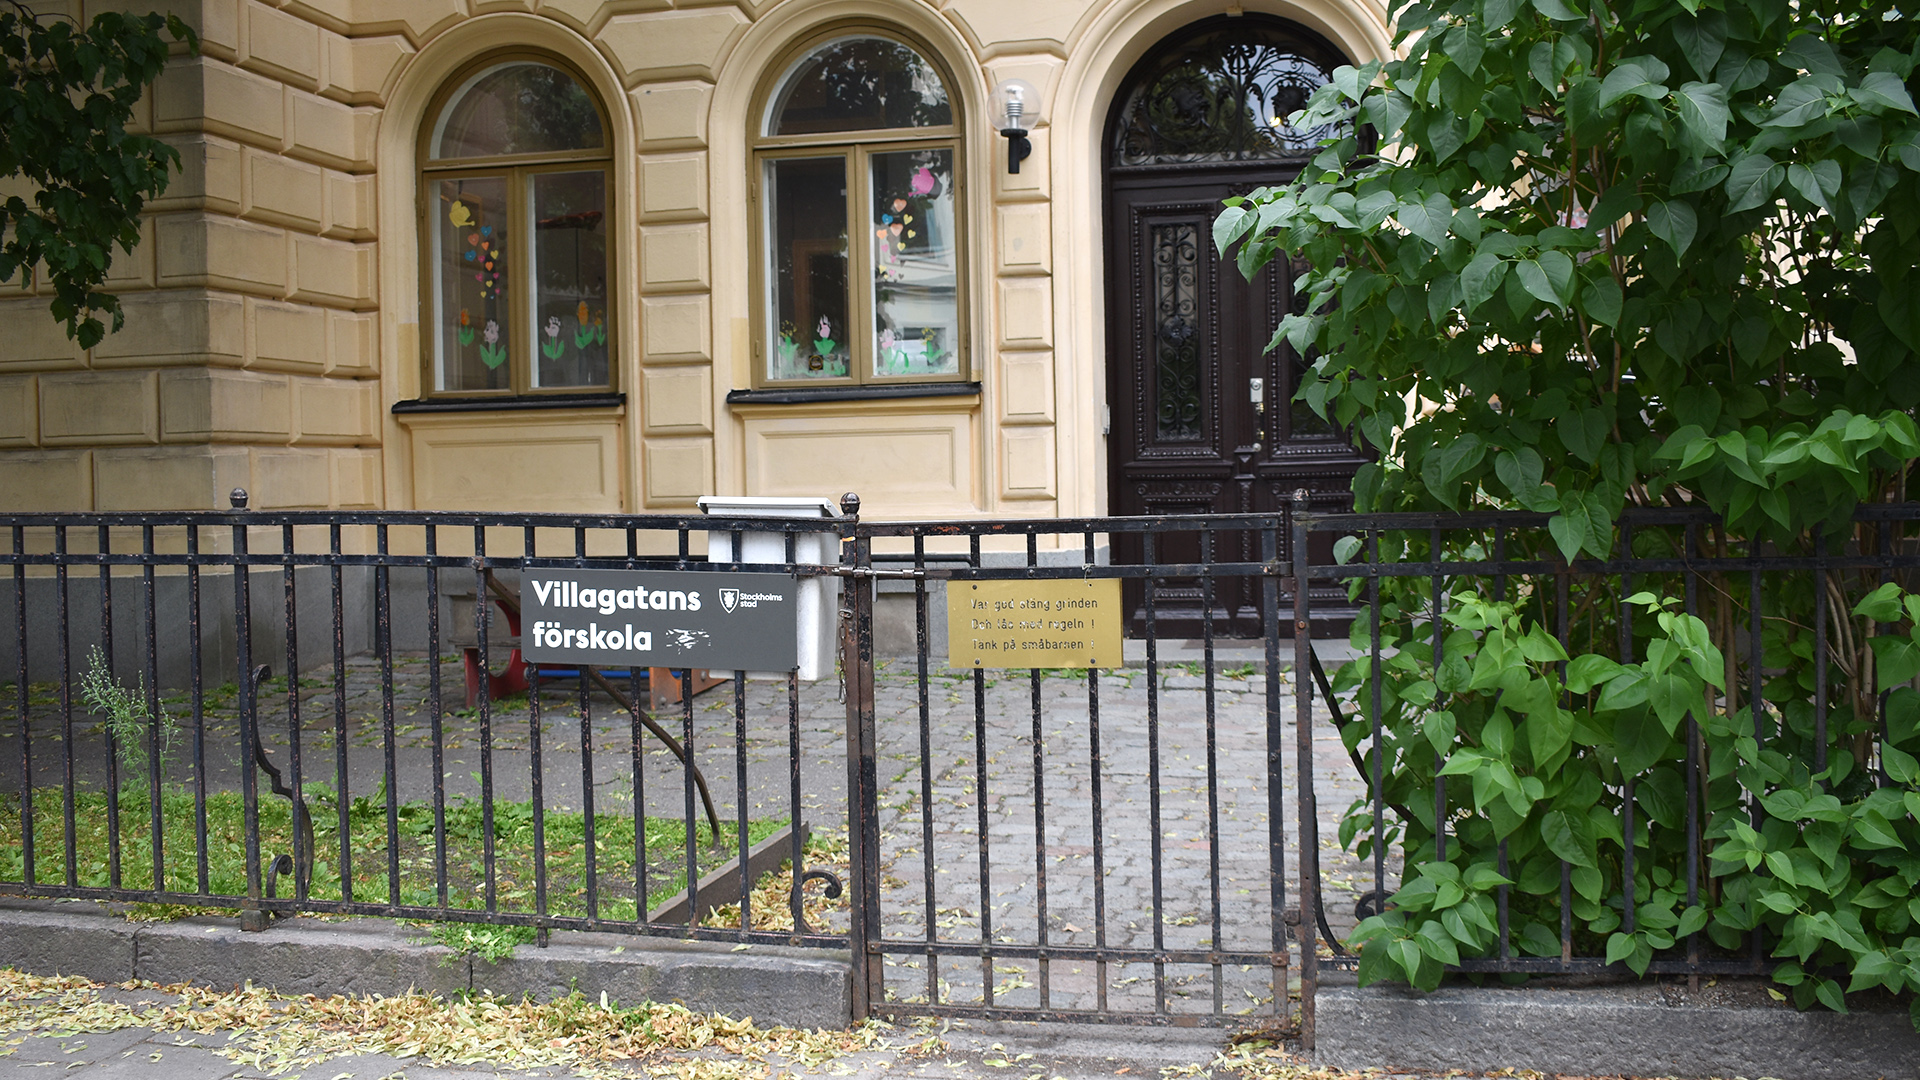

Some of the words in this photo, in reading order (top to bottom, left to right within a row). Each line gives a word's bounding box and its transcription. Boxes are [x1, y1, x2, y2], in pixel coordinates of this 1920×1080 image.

[531, 580, 701, 615] Villagatans
[740, 592, 783, 602] Stockholms
[740, 600, 758, 608] stad
[970, 598, 988, 609] Var
[994, 599, 1014, 611] god
[1020, 598, 1050, 611] stäng
[1056, 598, 1098, 611] grinden
[971, 618, 992, 630] Och
[997, 618, 1014, 629] lås
[1019, 618, 1043, 630] med
[1048, 618, 1084, 631] regeln
[533, 621, 652, 651] förskola
[1003, 637, 1016, 652] på
[1021, 638, 1084, 649] småbarnen
